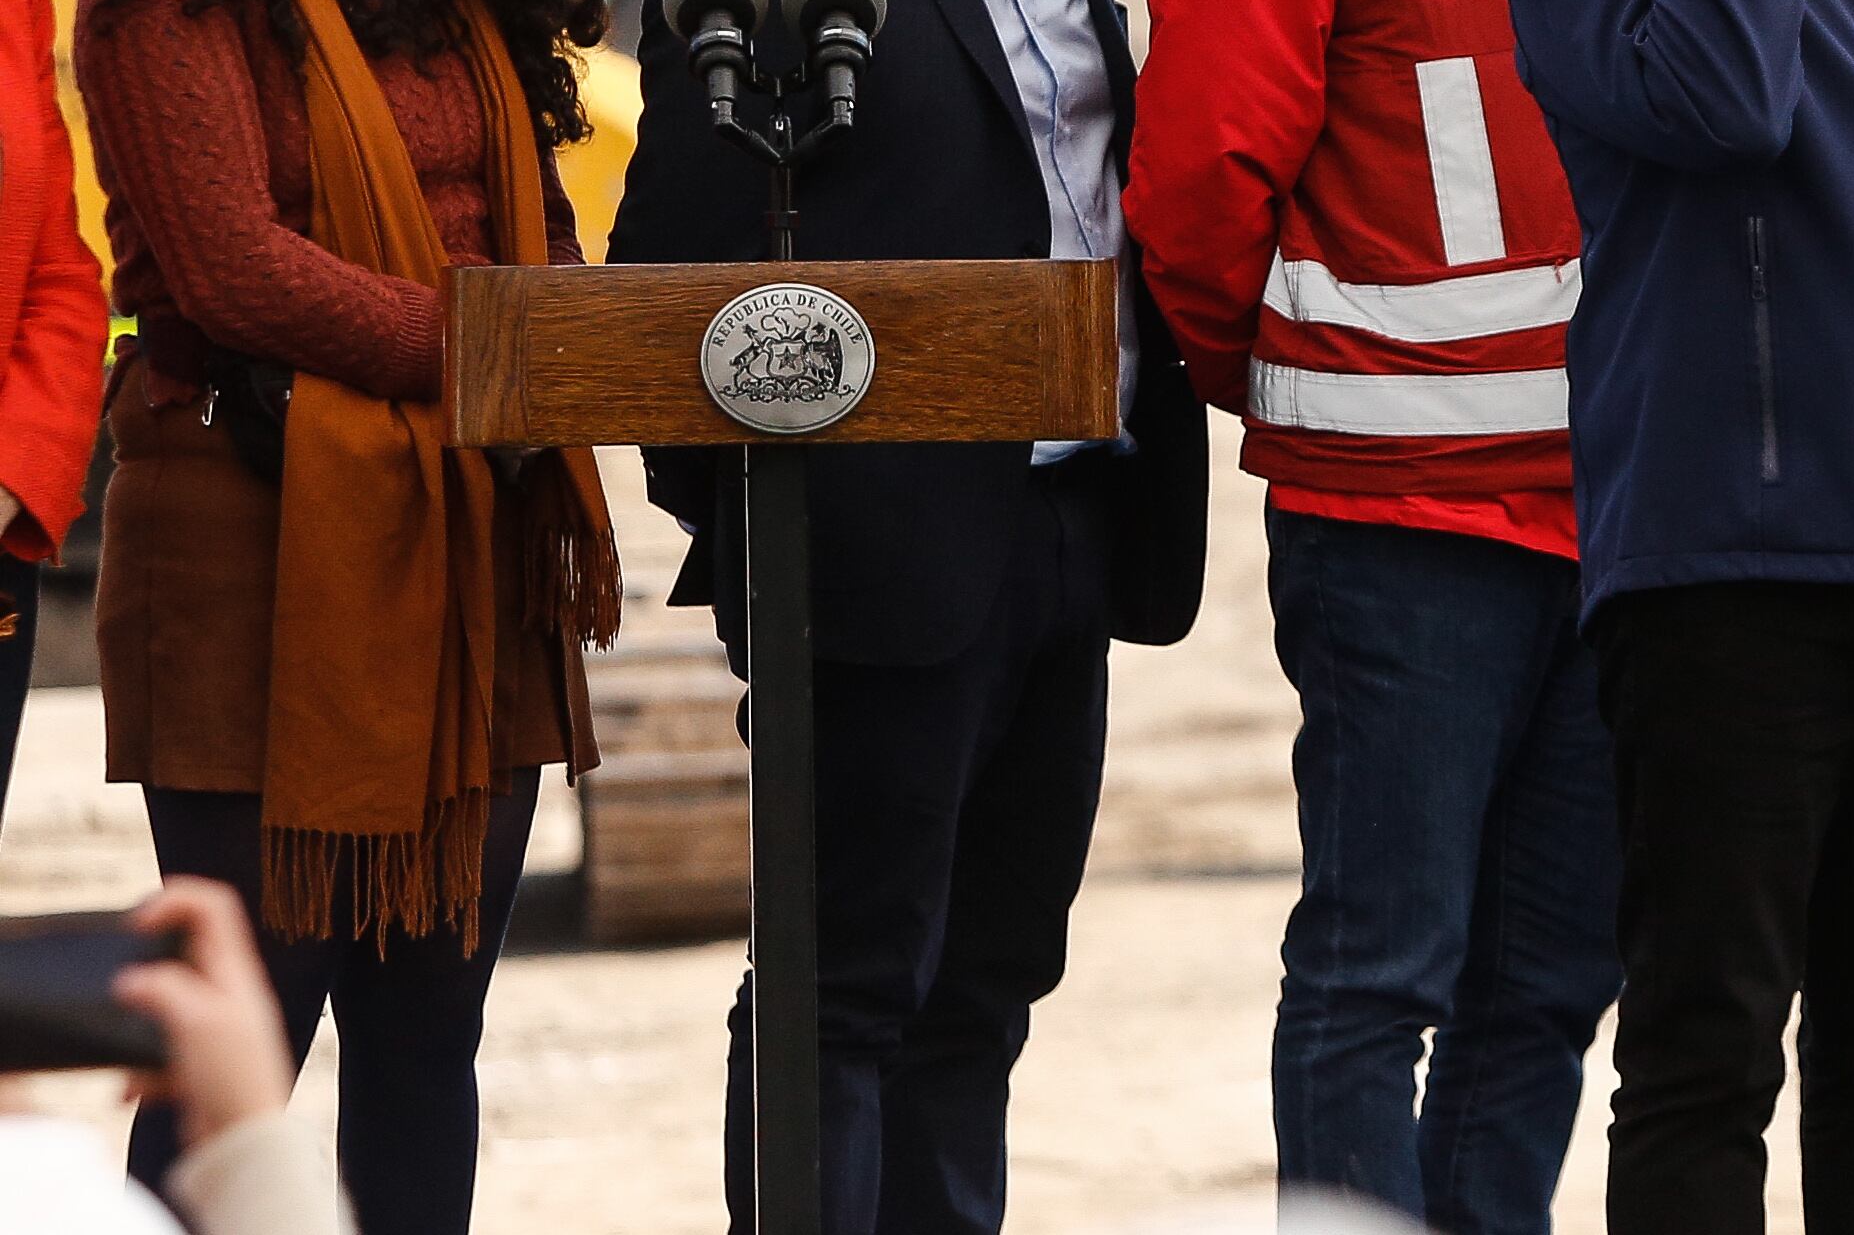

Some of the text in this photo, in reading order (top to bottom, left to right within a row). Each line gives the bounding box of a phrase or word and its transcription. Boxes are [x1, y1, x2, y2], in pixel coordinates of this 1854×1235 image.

[712, 293, 864, 347] REPUBLICA DE CHILE
